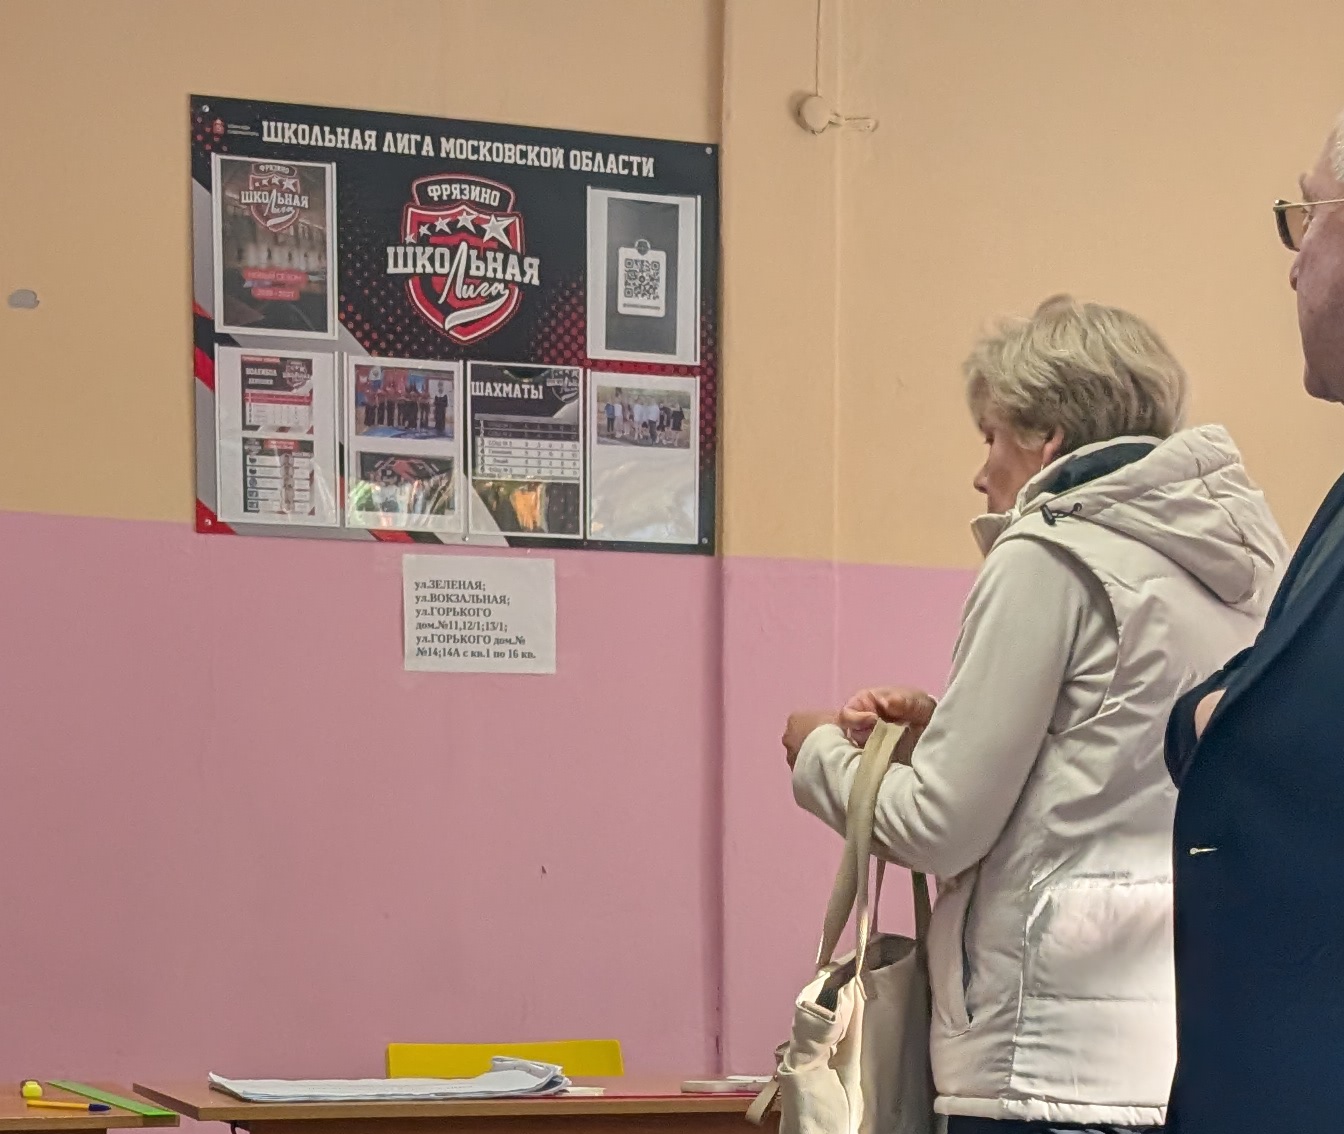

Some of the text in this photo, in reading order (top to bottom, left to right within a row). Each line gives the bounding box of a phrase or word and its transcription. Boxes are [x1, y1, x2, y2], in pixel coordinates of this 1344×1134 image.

[262, 120, 655, 178] ШКОЛЬНАЯ ЛИГА МОСКОВСКОЙ ОБЛАСТИ
[427, 183, 501, 207] ФРЯЗИНО
[386, 242, 540, 286] ШКОЛЬНАЯ
[471, 381, 544, 399] ШАХМАТЫ
[414, 579, 486, 591] ул.ЗЕЛЕНАЯ;
[415, 593, 510, 606] ул.ВОКЗАЛЬНАЯ;
[415, 606, 492, 618] ул.ГОРЬКОГО
[416, 633, 492, 645] ул.ГОРЬКОГО
